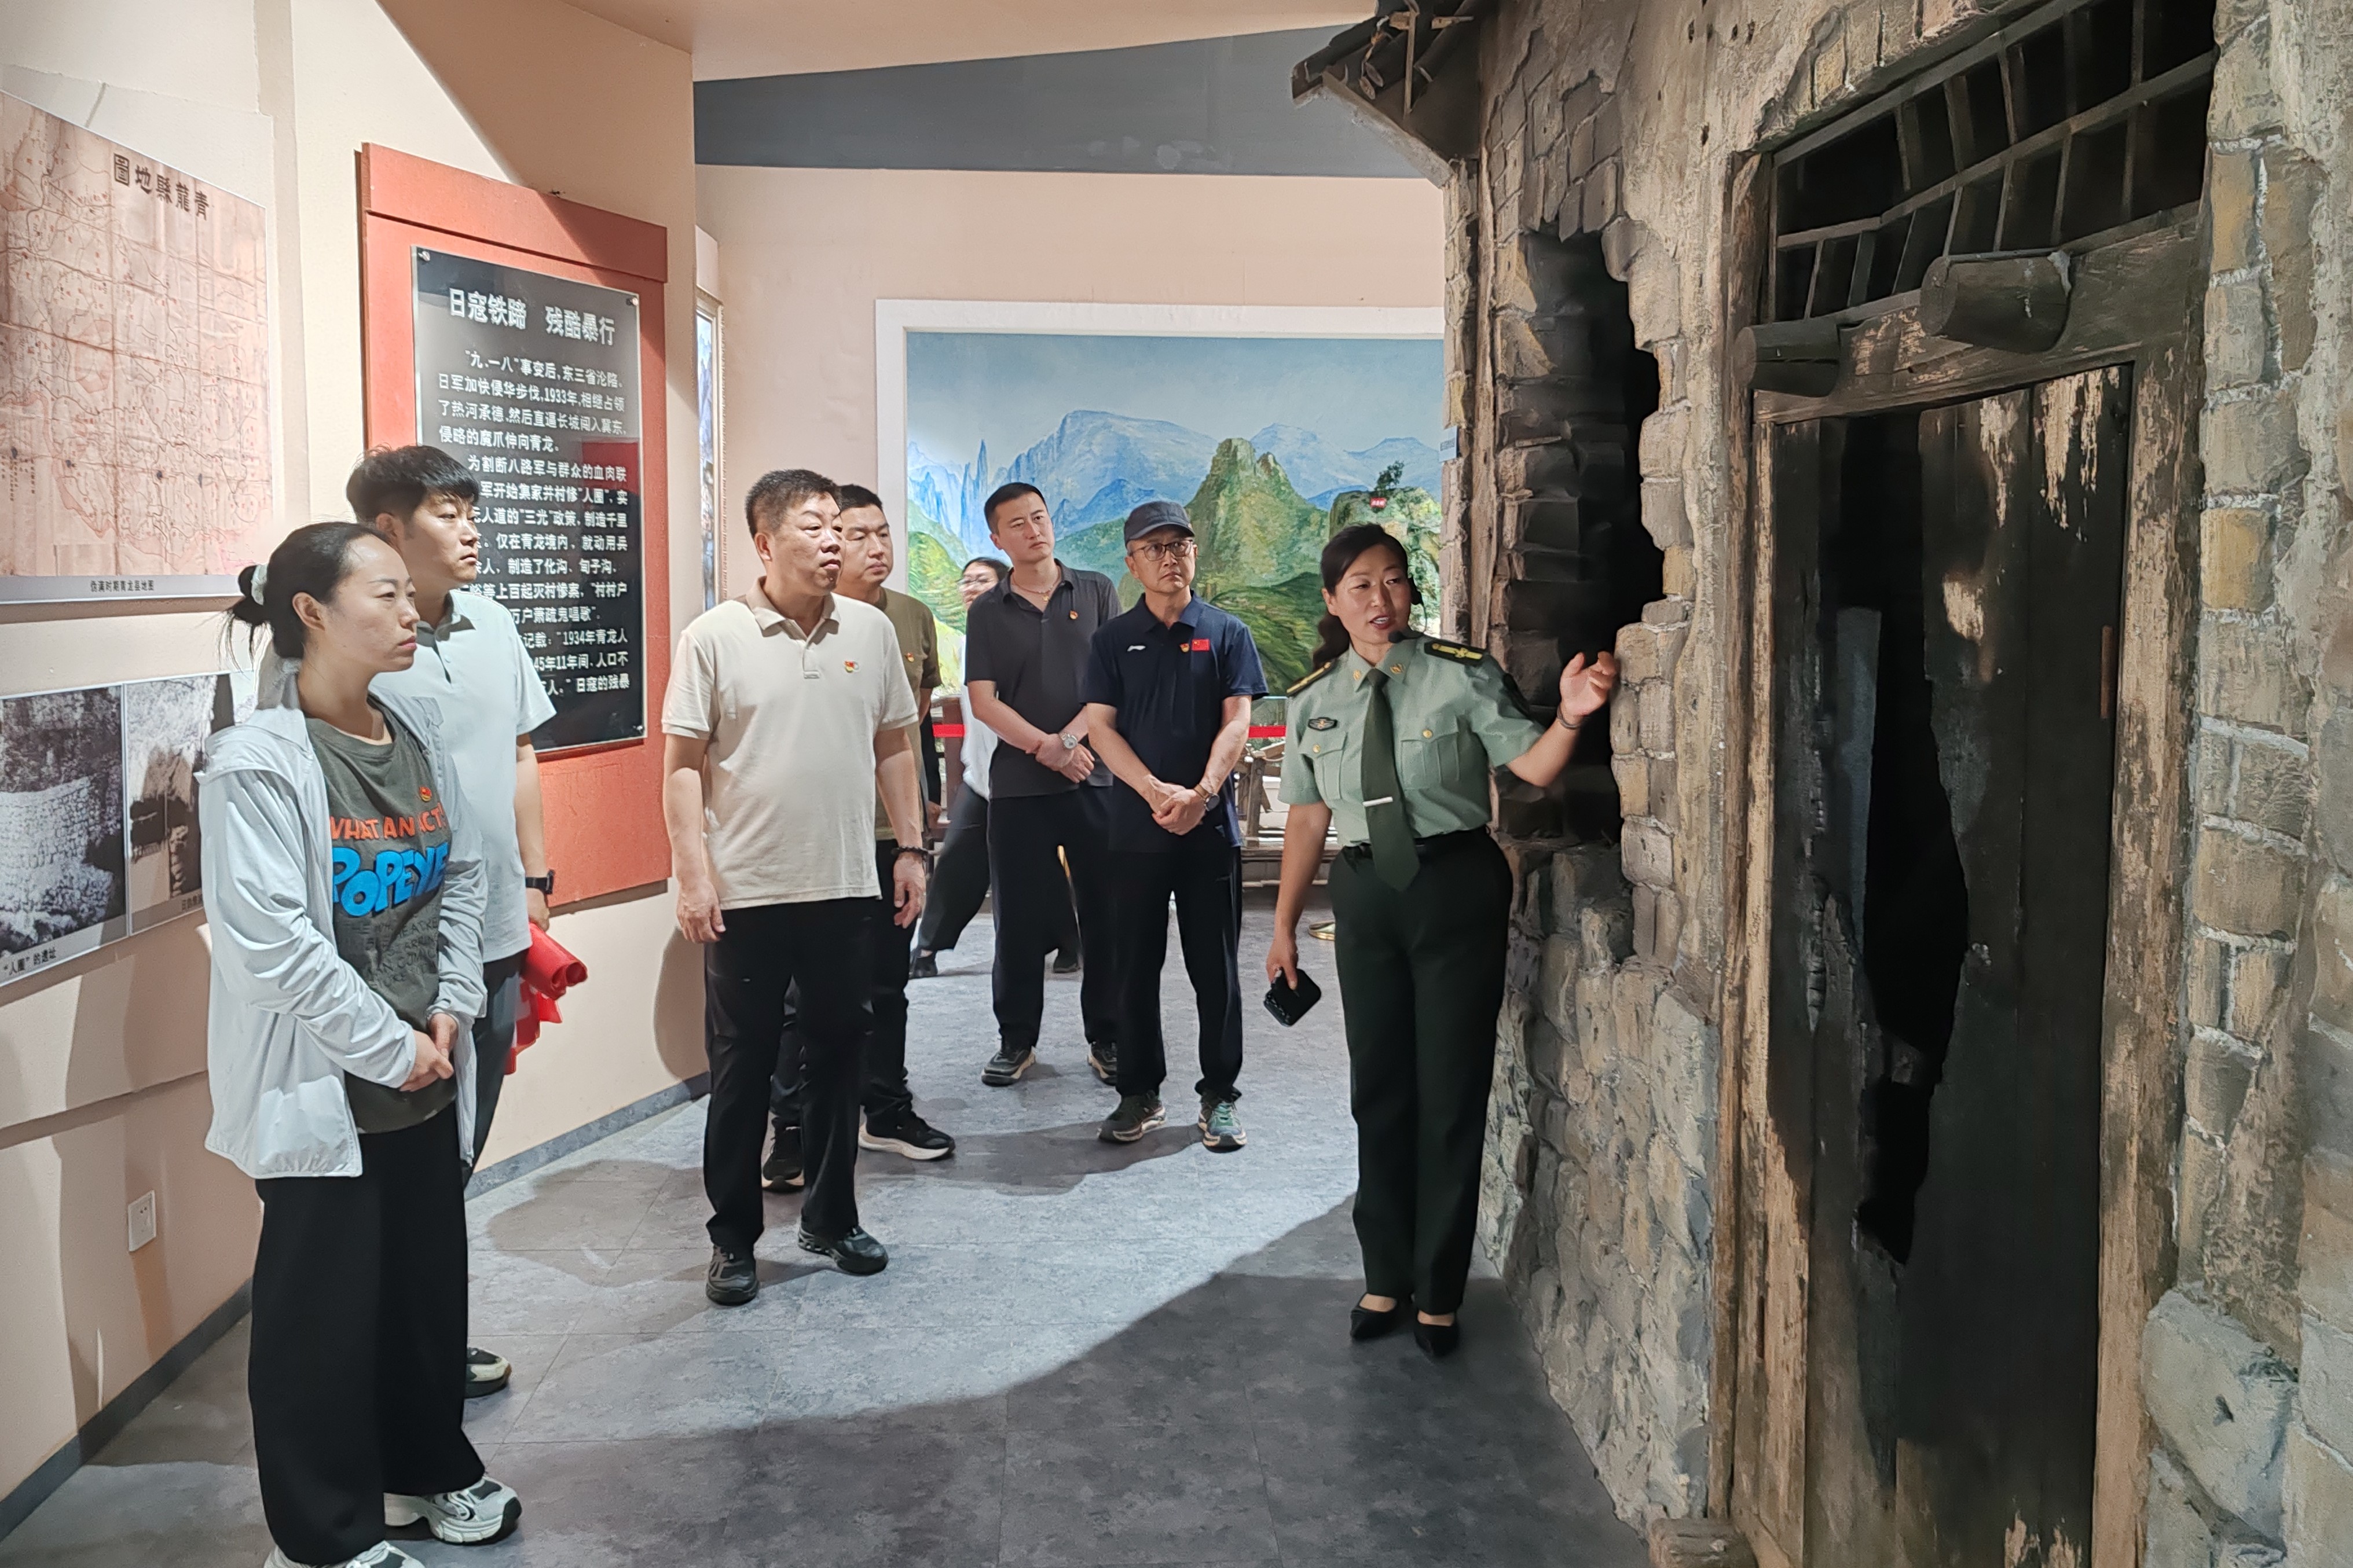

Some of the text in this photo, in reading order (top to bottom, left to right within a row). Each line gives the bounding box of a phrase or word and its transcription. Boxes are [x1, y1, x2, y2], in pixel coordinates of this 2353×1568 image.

[449, 288, 615, 346] 日寇铁蹄 残酷暴行
[439, 425, 559, 452] 侵略的魔爪伸向青龙。
[468, 455, 626, 482] 为割断八路军与群众的血肉联
[383, 816, 415, 840] AN
[332, 842, 448, 917] POPEYE
